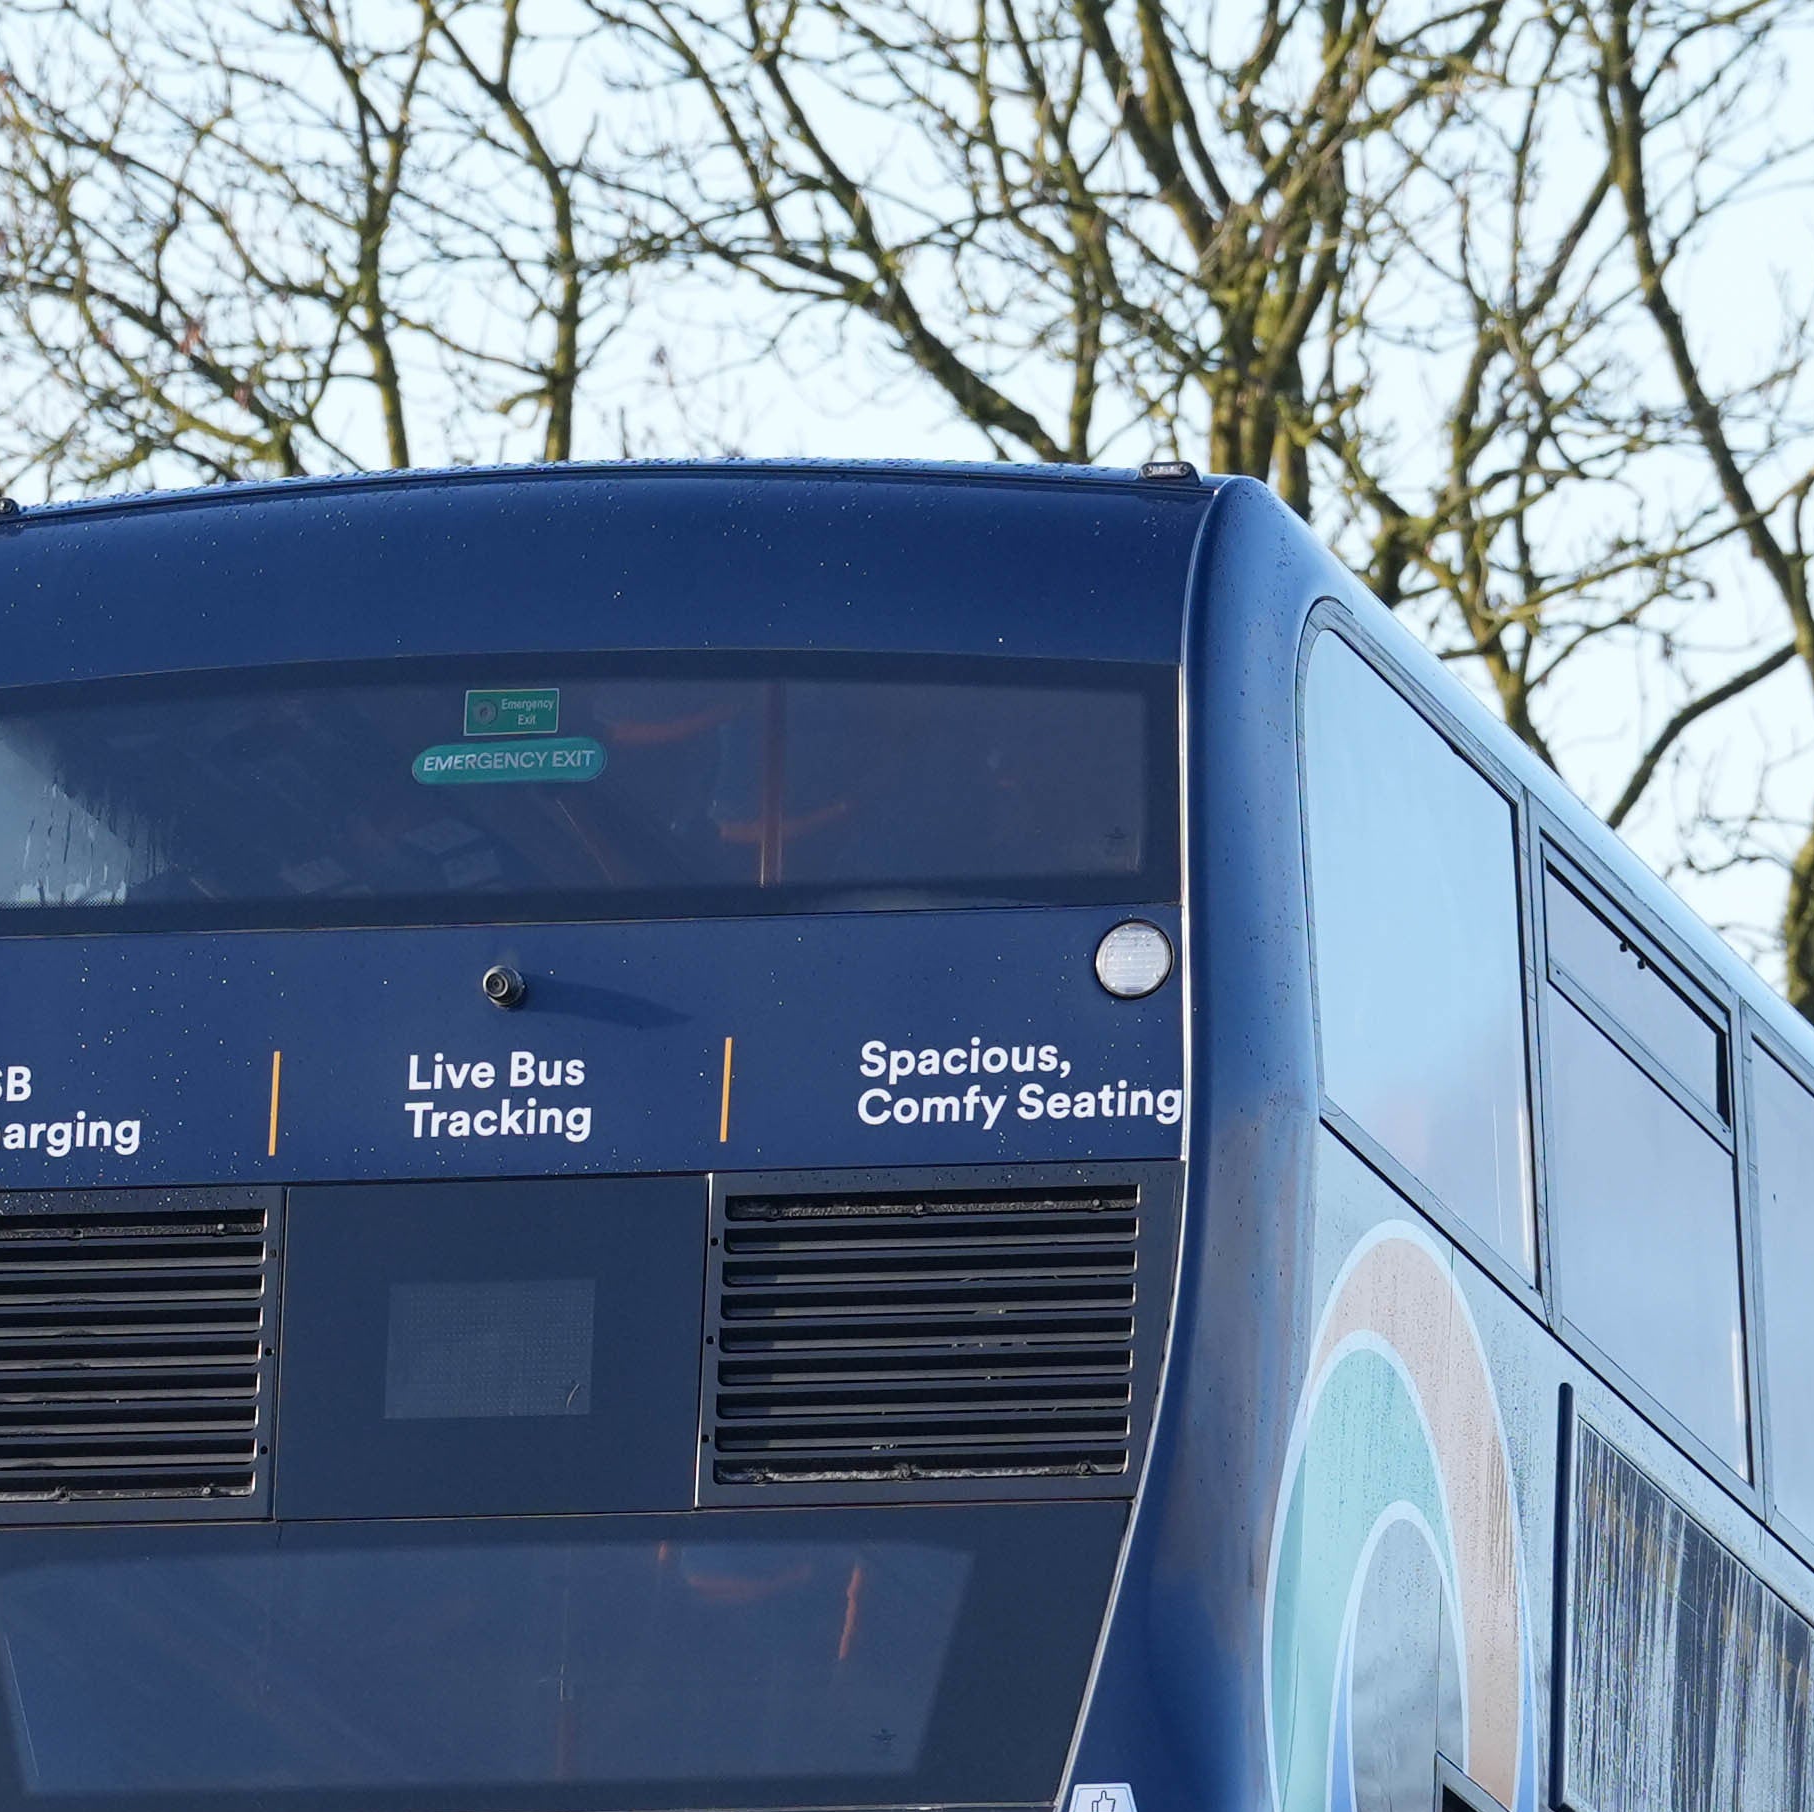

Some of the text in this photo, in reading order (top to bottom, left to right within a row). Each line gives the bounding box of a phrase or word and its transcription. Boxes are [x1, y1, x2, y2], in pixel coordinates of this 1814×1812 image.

[502, 698, 554, 712] Emergency
[518, 713, 536, 726] Exit
[423, 749, 595, 772] EMERGENCY EXIT
[408, 1051, 585, 1090] Live Bus
[860, 1036, 1071, 1084] Spacious,
[404, 1098, 592, 1143] Tracking
[857, 1079, 1183, 1130] Comfy Seating
